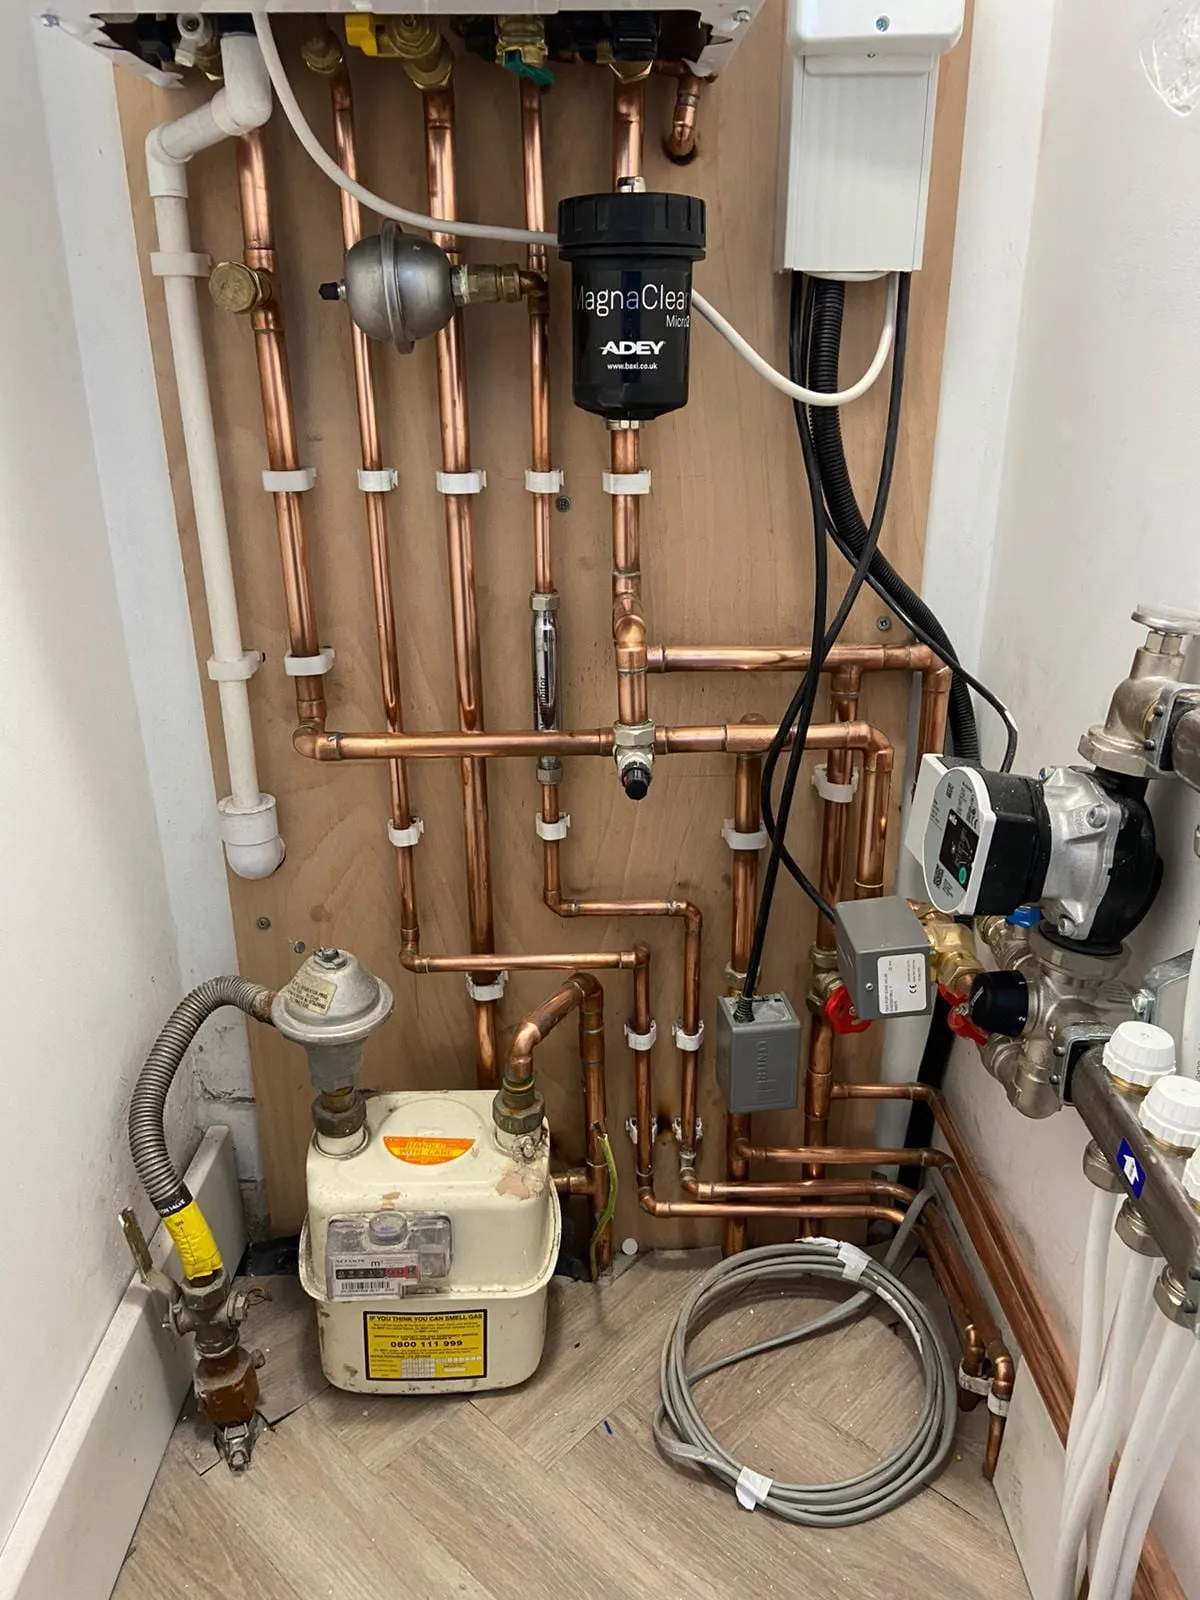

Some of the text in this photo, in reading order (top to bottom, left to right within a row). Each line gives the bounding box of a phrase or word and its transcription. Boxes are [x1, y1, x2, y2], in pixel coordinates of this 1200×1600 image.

[600, 341, 665, 355] ADEY
[607, 362, 658, 370] www.baxi.co.uk
[421, 1340, 439, 1348] 111
